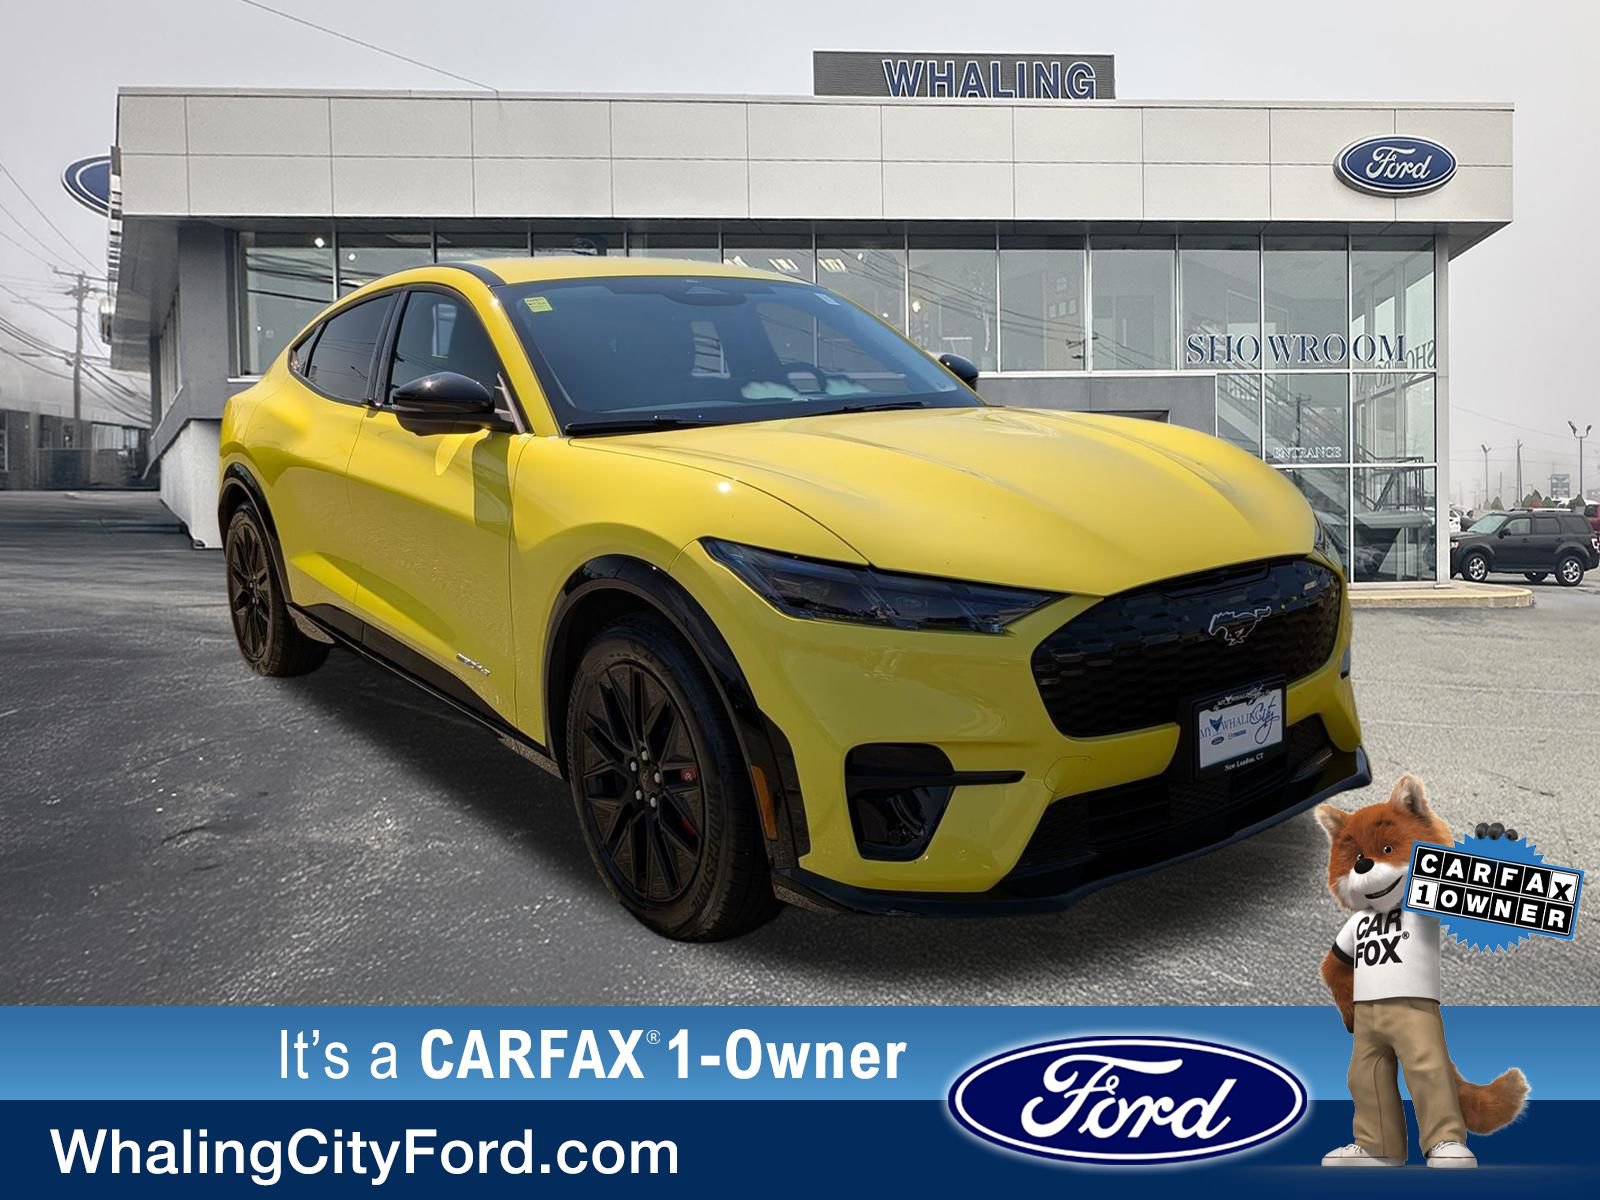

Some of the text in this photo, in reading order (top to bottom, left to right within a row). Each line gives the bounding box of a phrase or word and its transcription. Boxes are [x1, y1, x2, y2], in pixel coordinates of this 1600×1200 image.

[882, 59, 1096, 99] WHALING
[1365, 146, 1432, 178] Ford
[1273, 446, 1342, 458] ENTRANCE
[1256, 752, 1264, 762] CT
